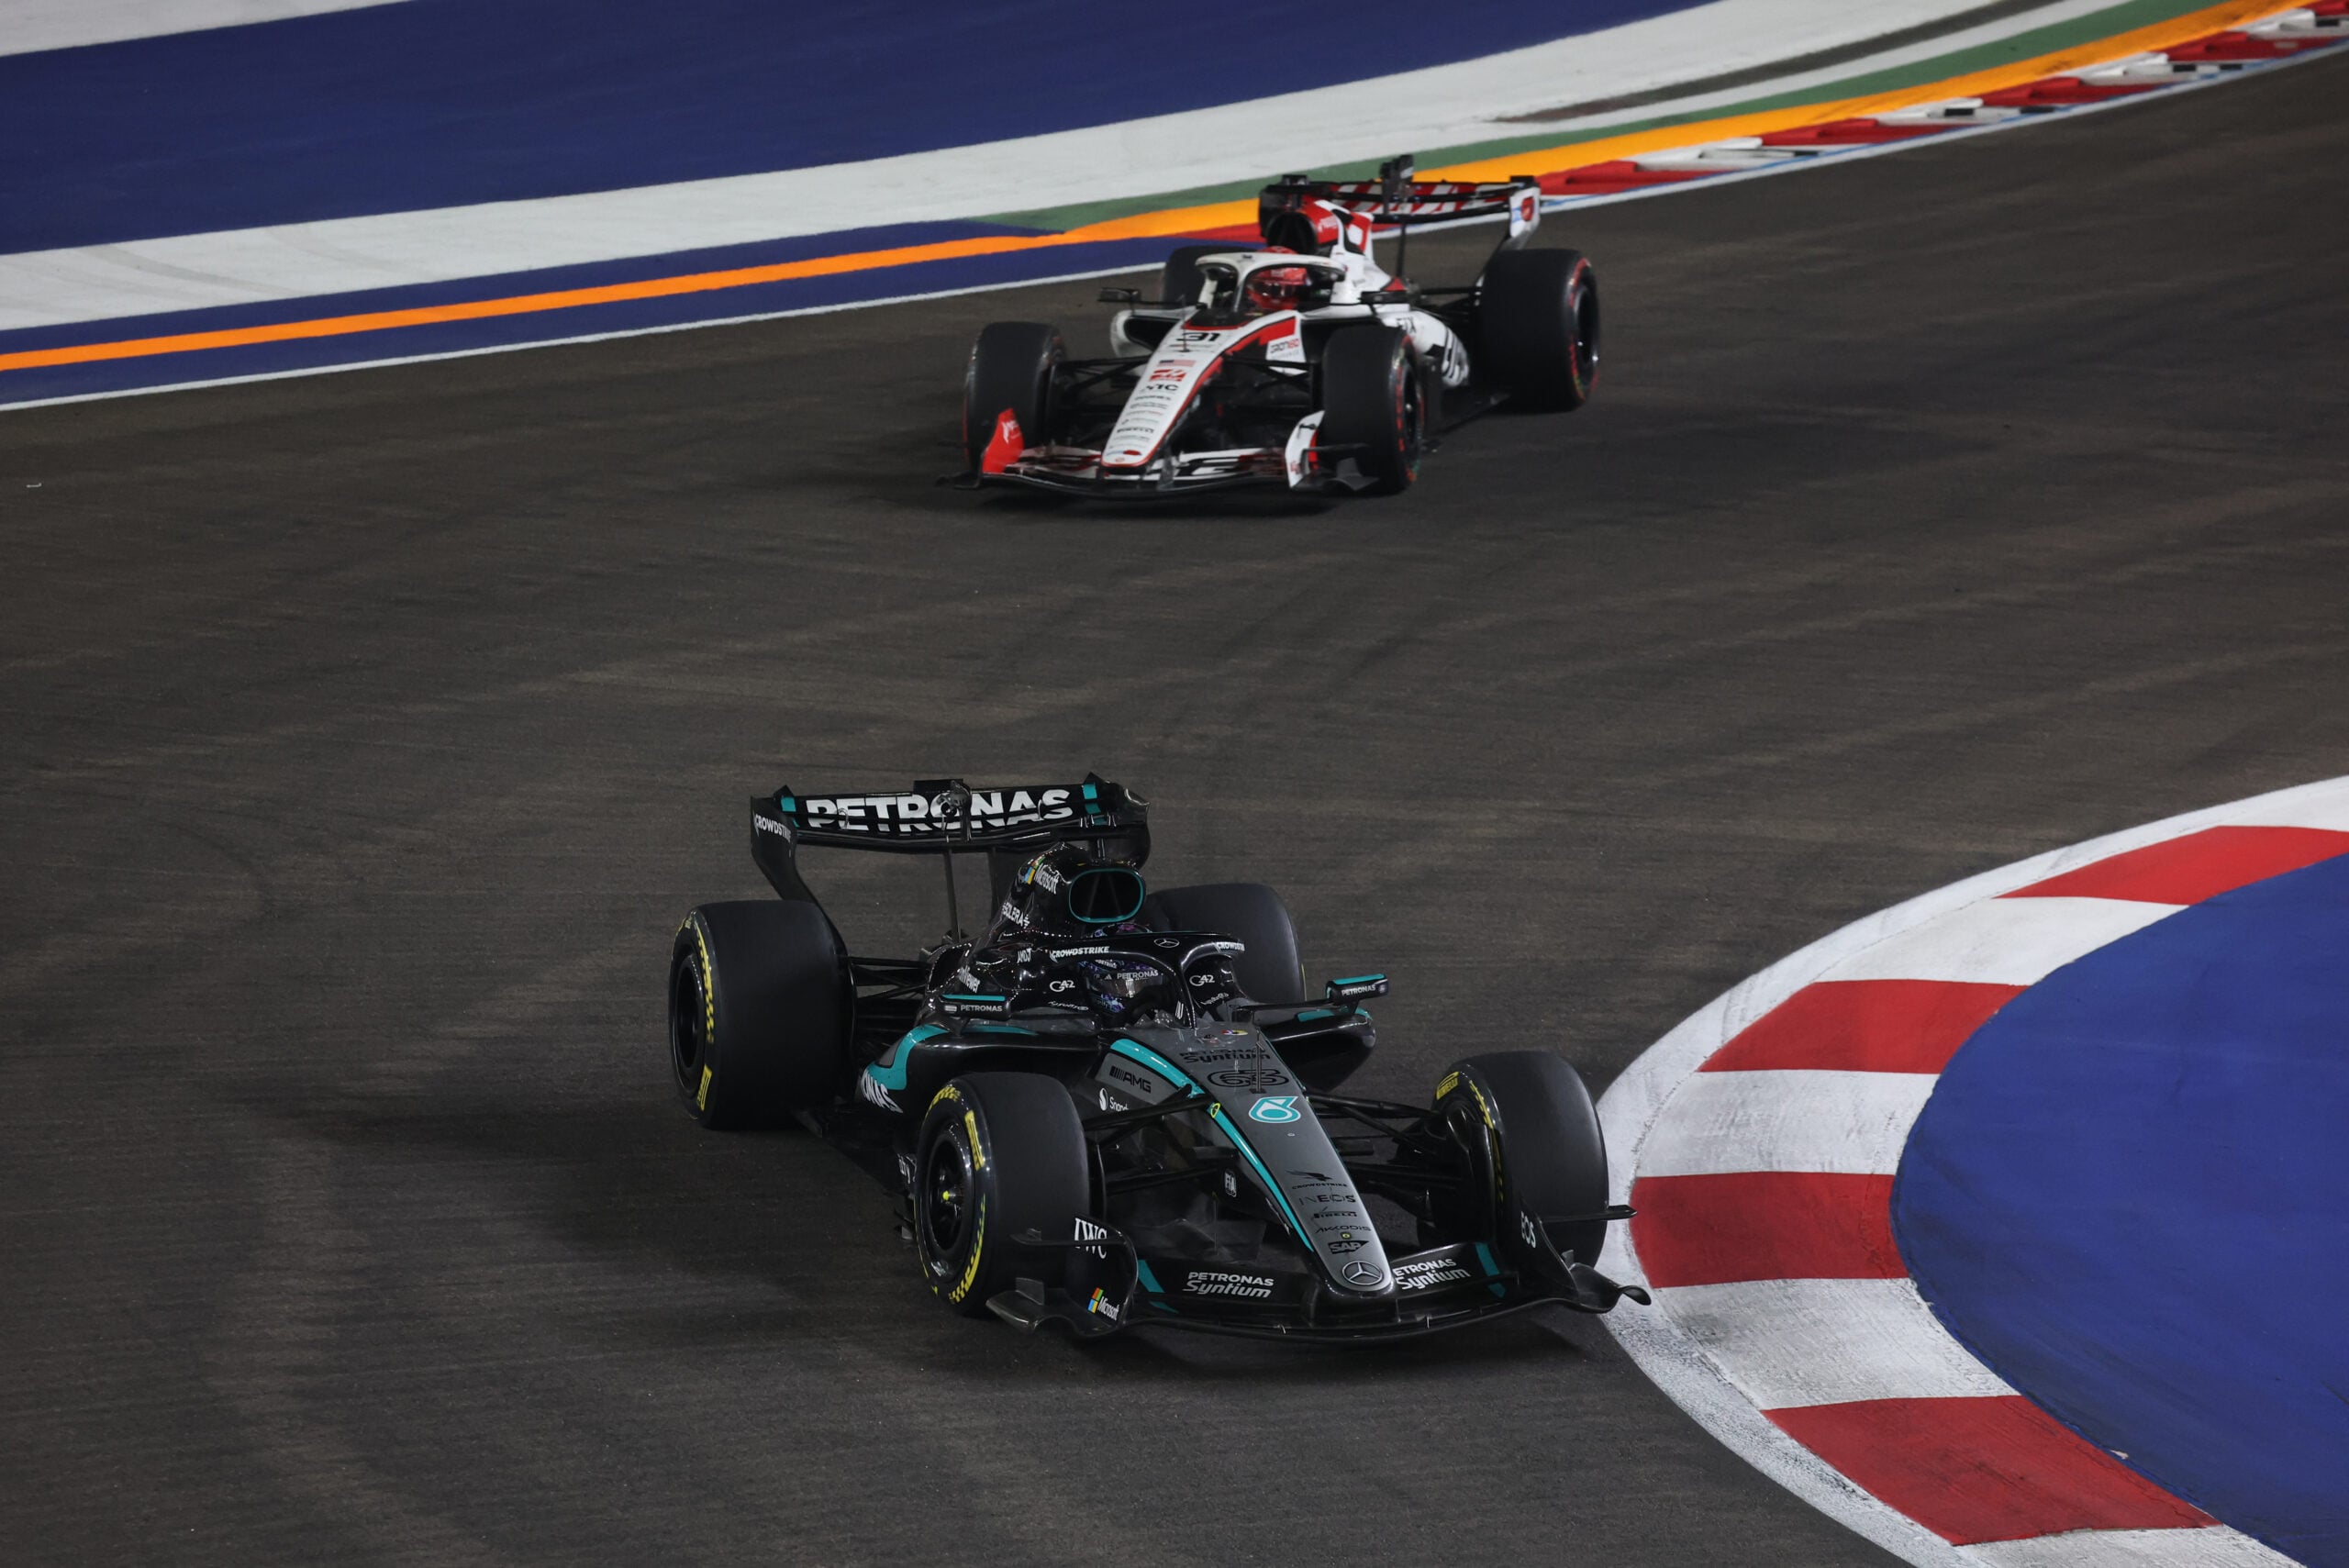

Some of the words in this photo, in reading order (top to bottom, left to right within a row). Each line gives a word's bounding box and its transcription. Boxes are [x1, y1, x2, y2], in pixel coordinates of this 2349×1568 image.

[1175, 331, 1221, 342] 31
[806, 789, 1074, 832] PETRONAS
[1051, 946, 1110, 959] CROWDSTRIKE
[1117, 969, 1159, 980] PETRONAS
[1189, 974, 1216, 986] G42
[1050, 980, 1075, 992] G42
[1341, 984, 1376, 996] PETRONAS
[1183, 1052, 1271, 1064] Syntium
[1123, 1072, 1152, 1094] AMG
[1292, 1182, 1348, 1190] CROWDSTRIKE
[1298, 1194, 1356, 1206] INEOS
[1329, 1241, 1363, 1254] SAP
[1393, 1258, 1457, 1277] ETRONAS
[1188, 1272, 1275, 1286] PETRONAS
[1394, 1268, 1471, 1291] Syntium
[1183, 1280, 1272, 1298] Syntium
[1098, 1296, 1120, 1321] Microsoft
